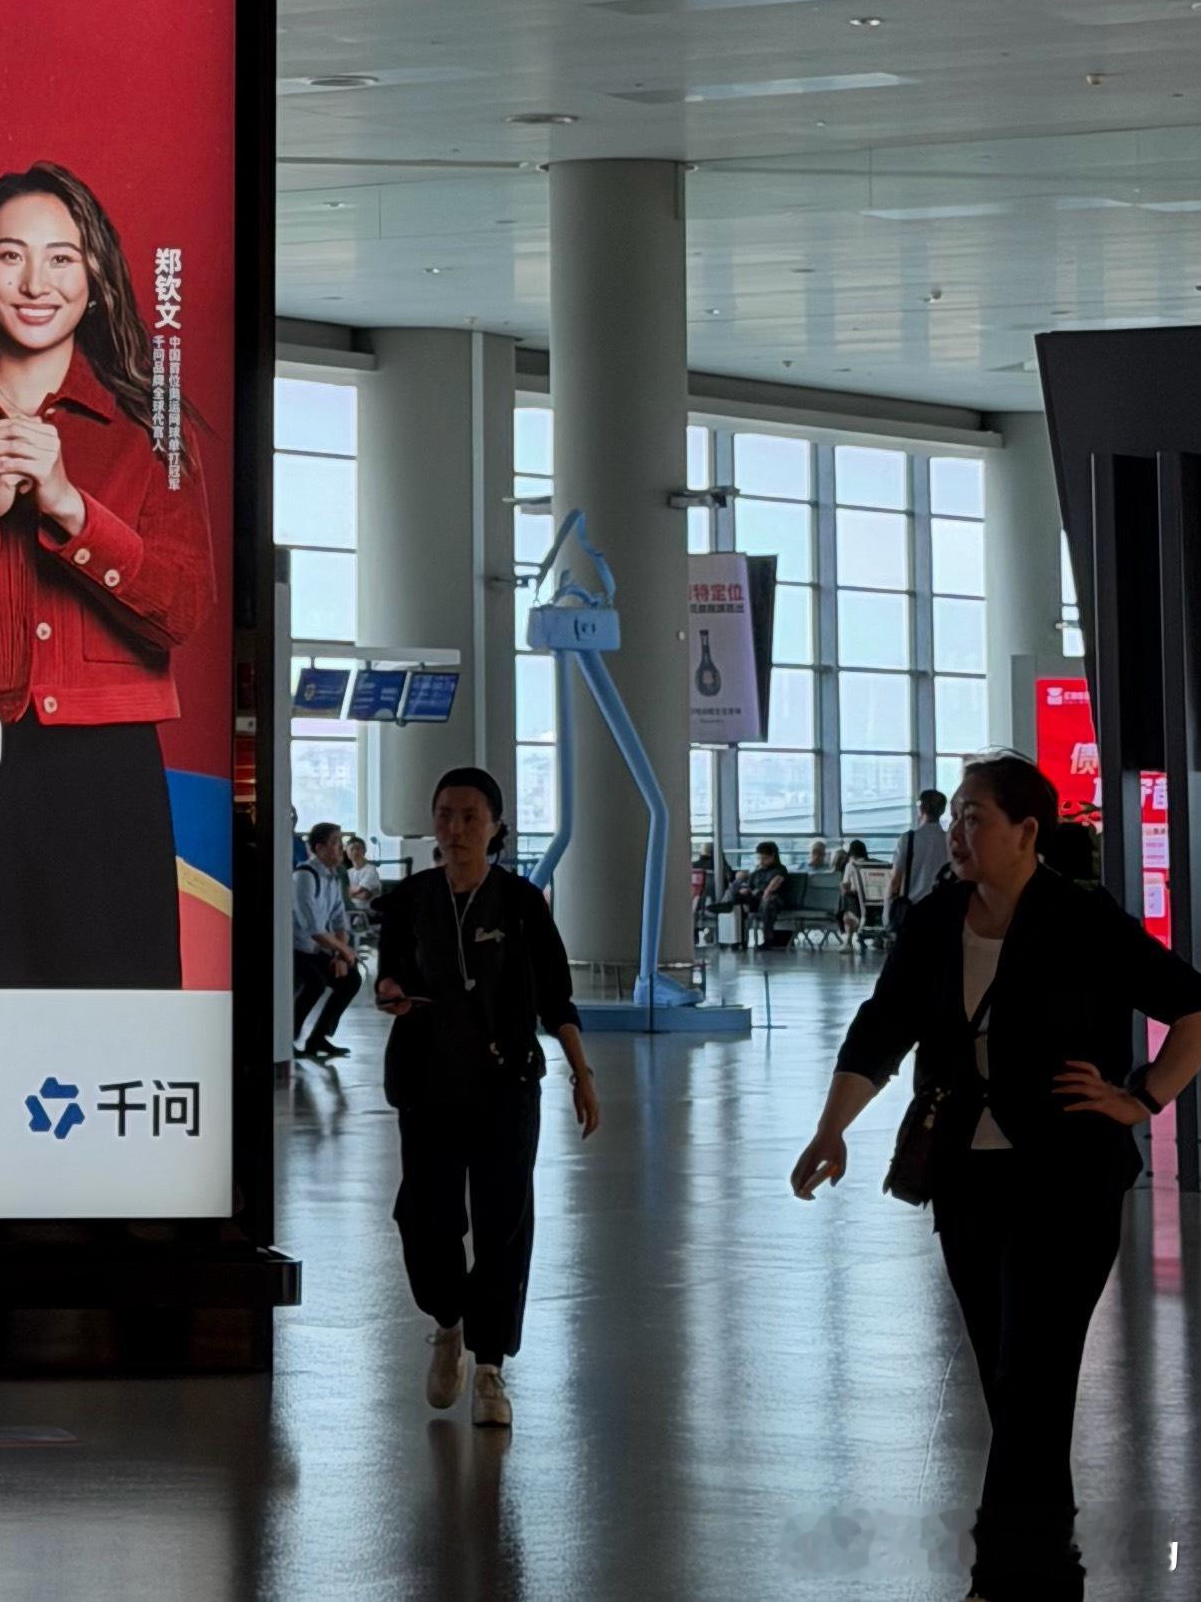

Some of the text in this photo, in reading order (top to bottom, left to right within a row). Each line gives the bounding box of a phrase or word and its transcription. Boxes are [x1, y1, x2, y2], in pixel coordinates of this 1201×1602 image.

[154, 248, 182, 330] 郑钦文
[689, 584, 745, 602] 特定位
[97, 1079, 201, 1138] 千问
